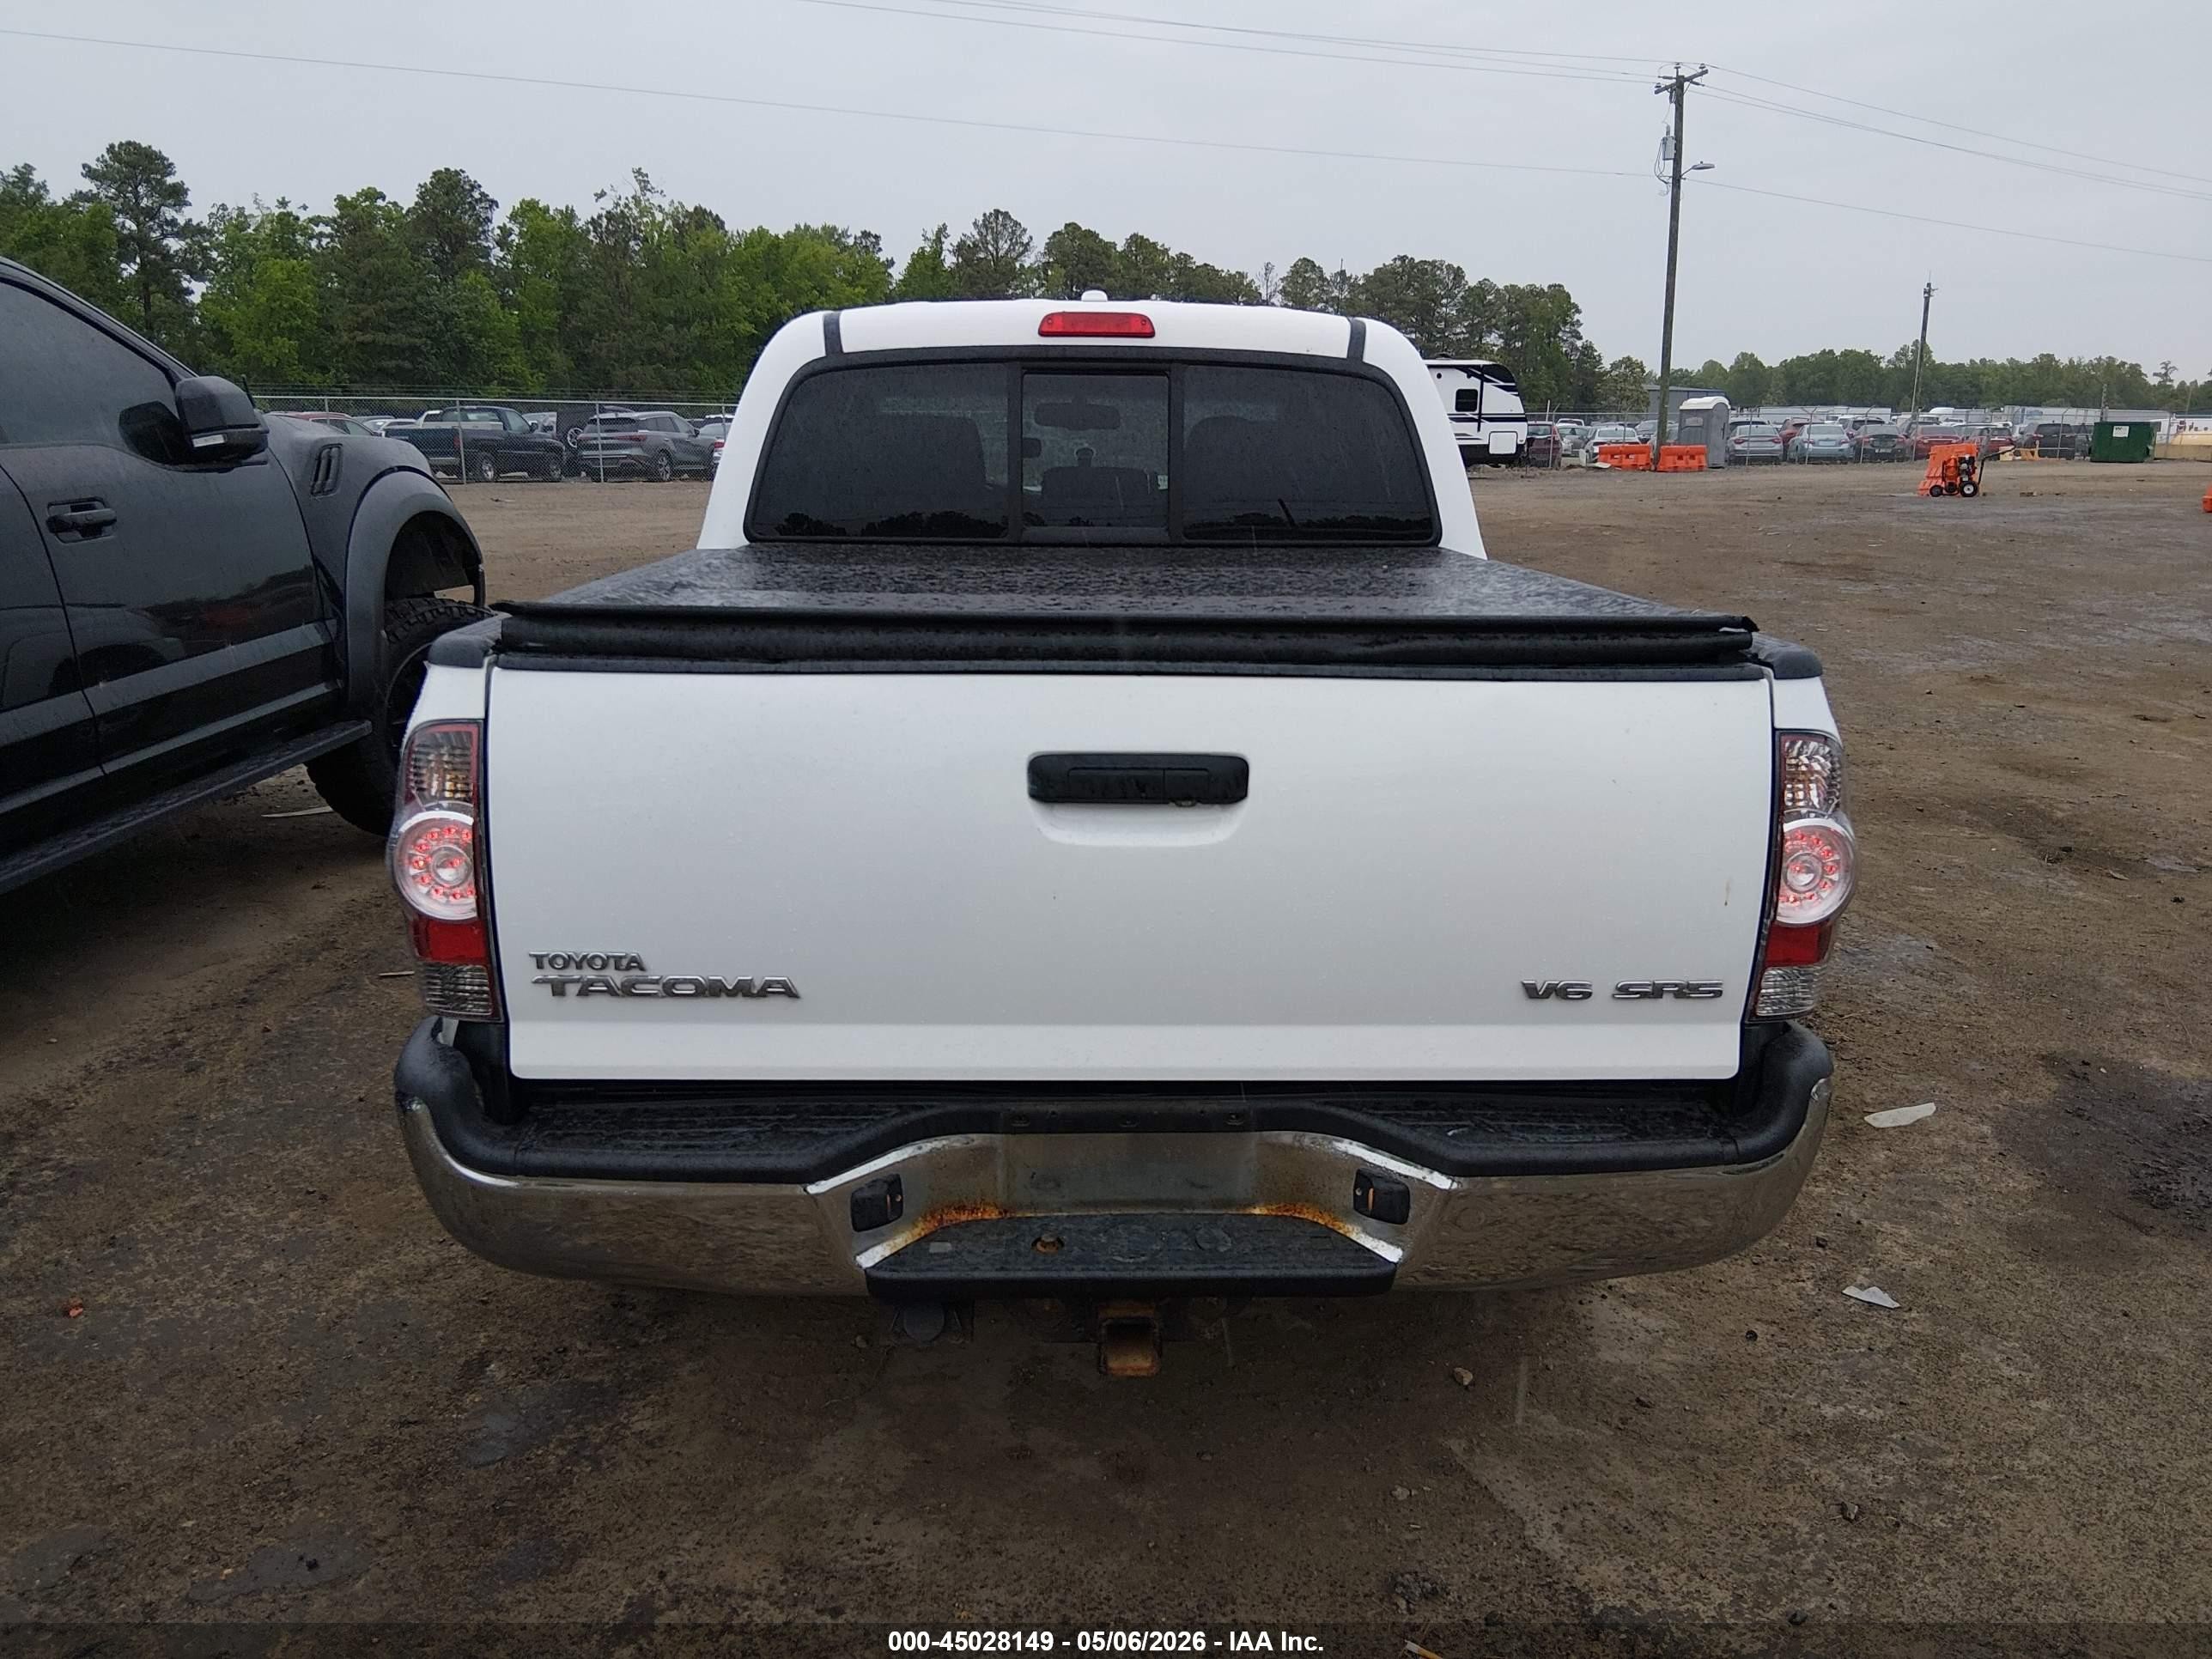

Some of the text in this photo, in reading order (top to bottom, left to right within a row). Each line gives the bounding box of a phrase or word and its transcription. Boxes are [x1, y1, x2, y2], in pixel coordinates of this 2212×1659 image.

[529, 951, 647, 971] TOYOTA
[532, 975, 800, 999] TACOMA
[1522, 980, 1723, 1000] V6 SR5
